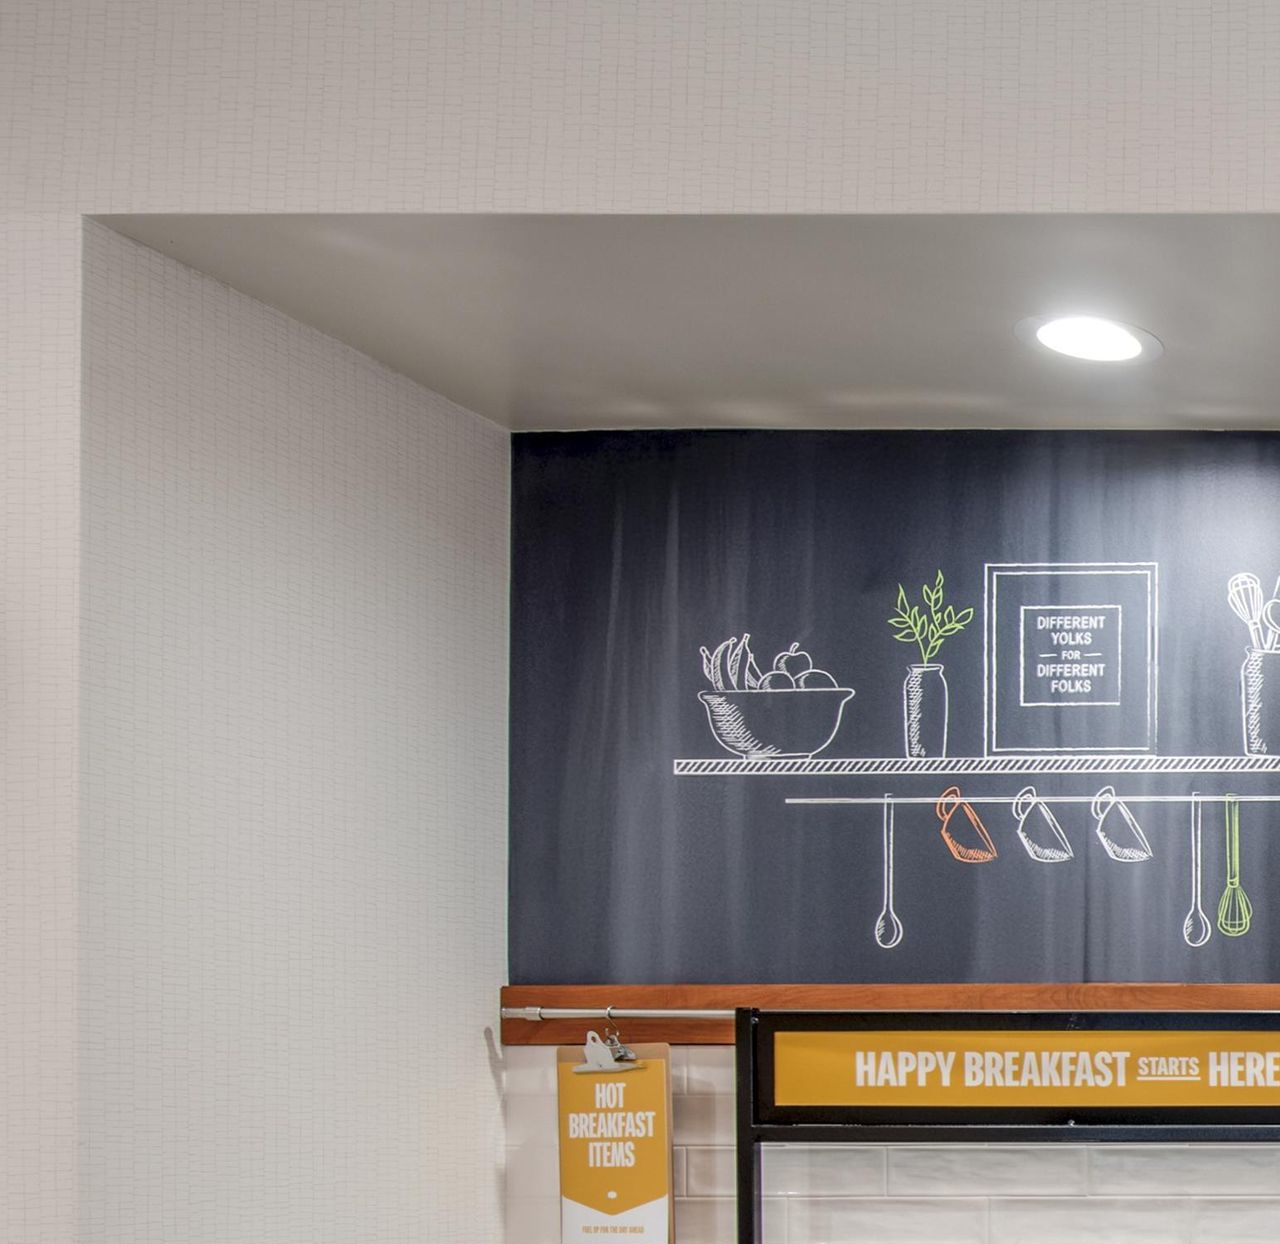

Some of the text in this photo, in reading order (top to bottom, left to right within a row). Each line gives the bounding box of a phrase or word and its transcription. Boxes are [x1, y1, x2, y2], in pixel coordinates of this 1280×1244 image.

[1037, 616, 1106, 629] DIFFERENT
[1051, 632, 1092, 645] YOLKS
[1061, 650, 1081, 660] FOR
[1037, 663, 1106, 677] DIFFERENT
[1051, 680, 1092, 693] FOLKS
[855, 1051, 955, 1087] HAPPY
[964, 1051, 1131, 1087] BREAKFAST
[1137, 1056, 1200, 1076] STARTS
[595, 1082, 626, 1109] HOT
[569, 1111, 656, 1138] BREAKFAST
[588, 1141, 635, 1168] ITEMS
